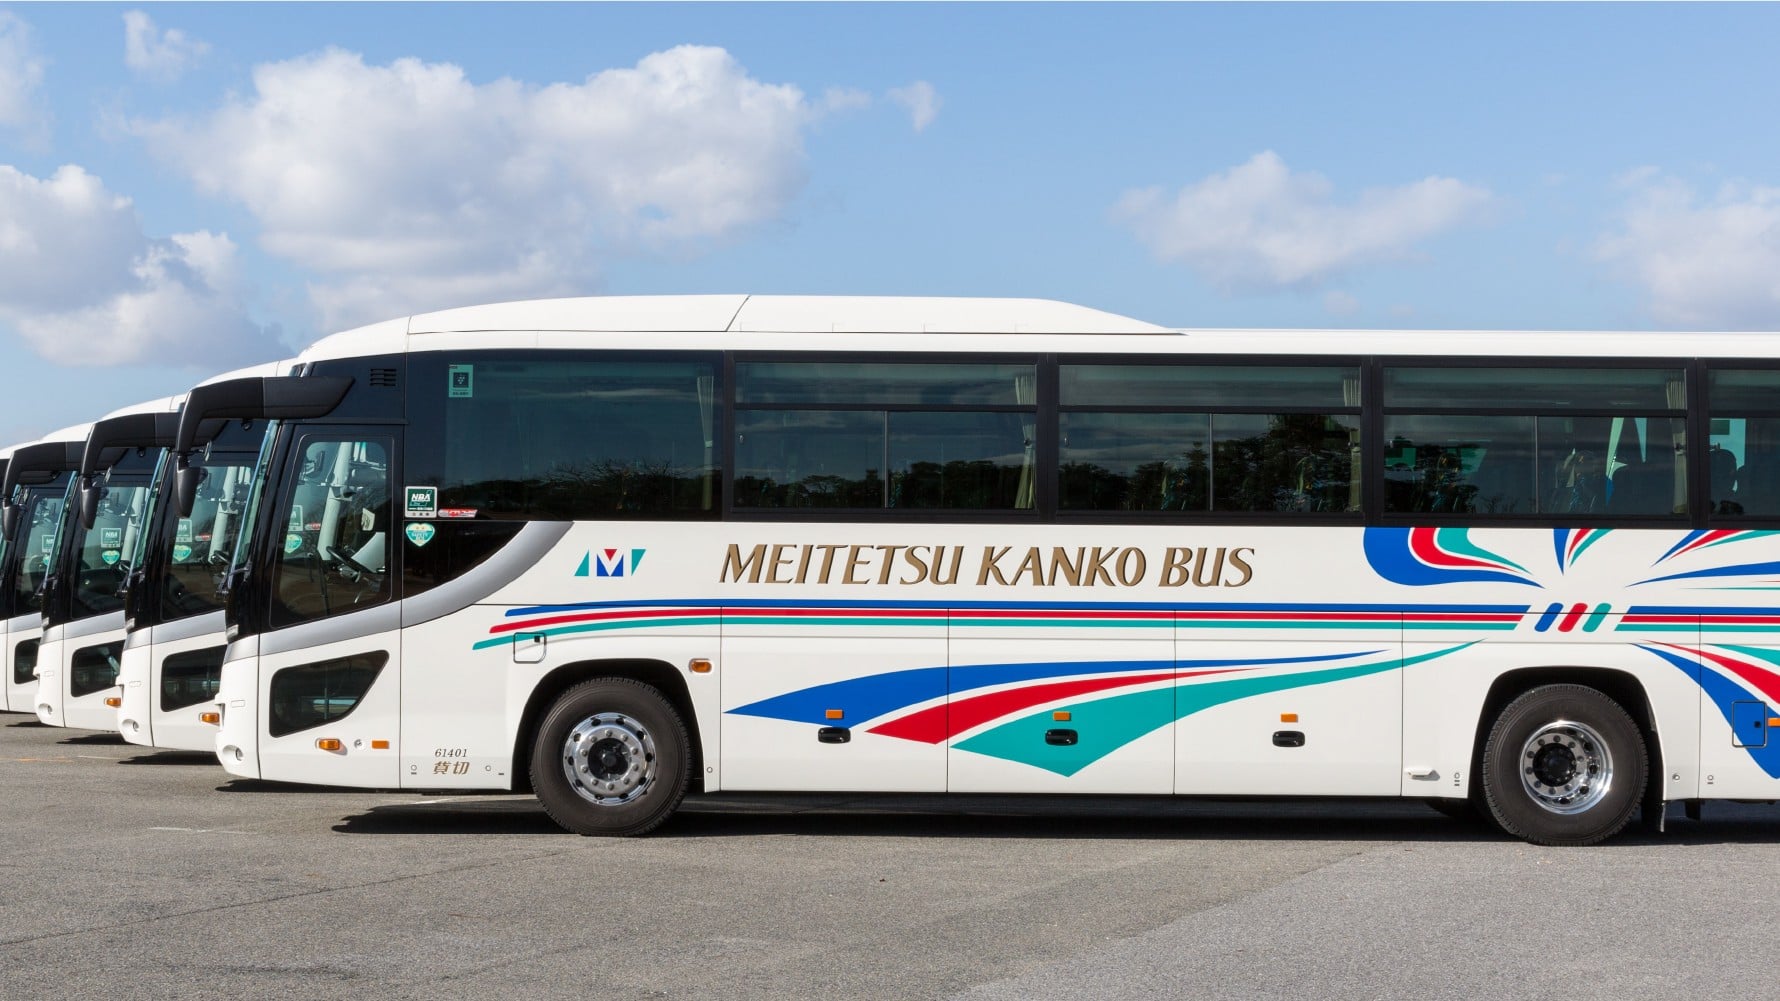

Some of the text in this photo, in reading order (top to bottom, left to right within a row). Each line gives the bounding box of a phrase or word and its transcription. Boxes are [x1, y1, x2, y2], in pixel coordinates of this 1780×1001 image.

[411, 493, 431, 502] NBA
[718, 543, 1255, 588] MEITETSU KANKO BUS
[434, 748, 468, 758] 61401
